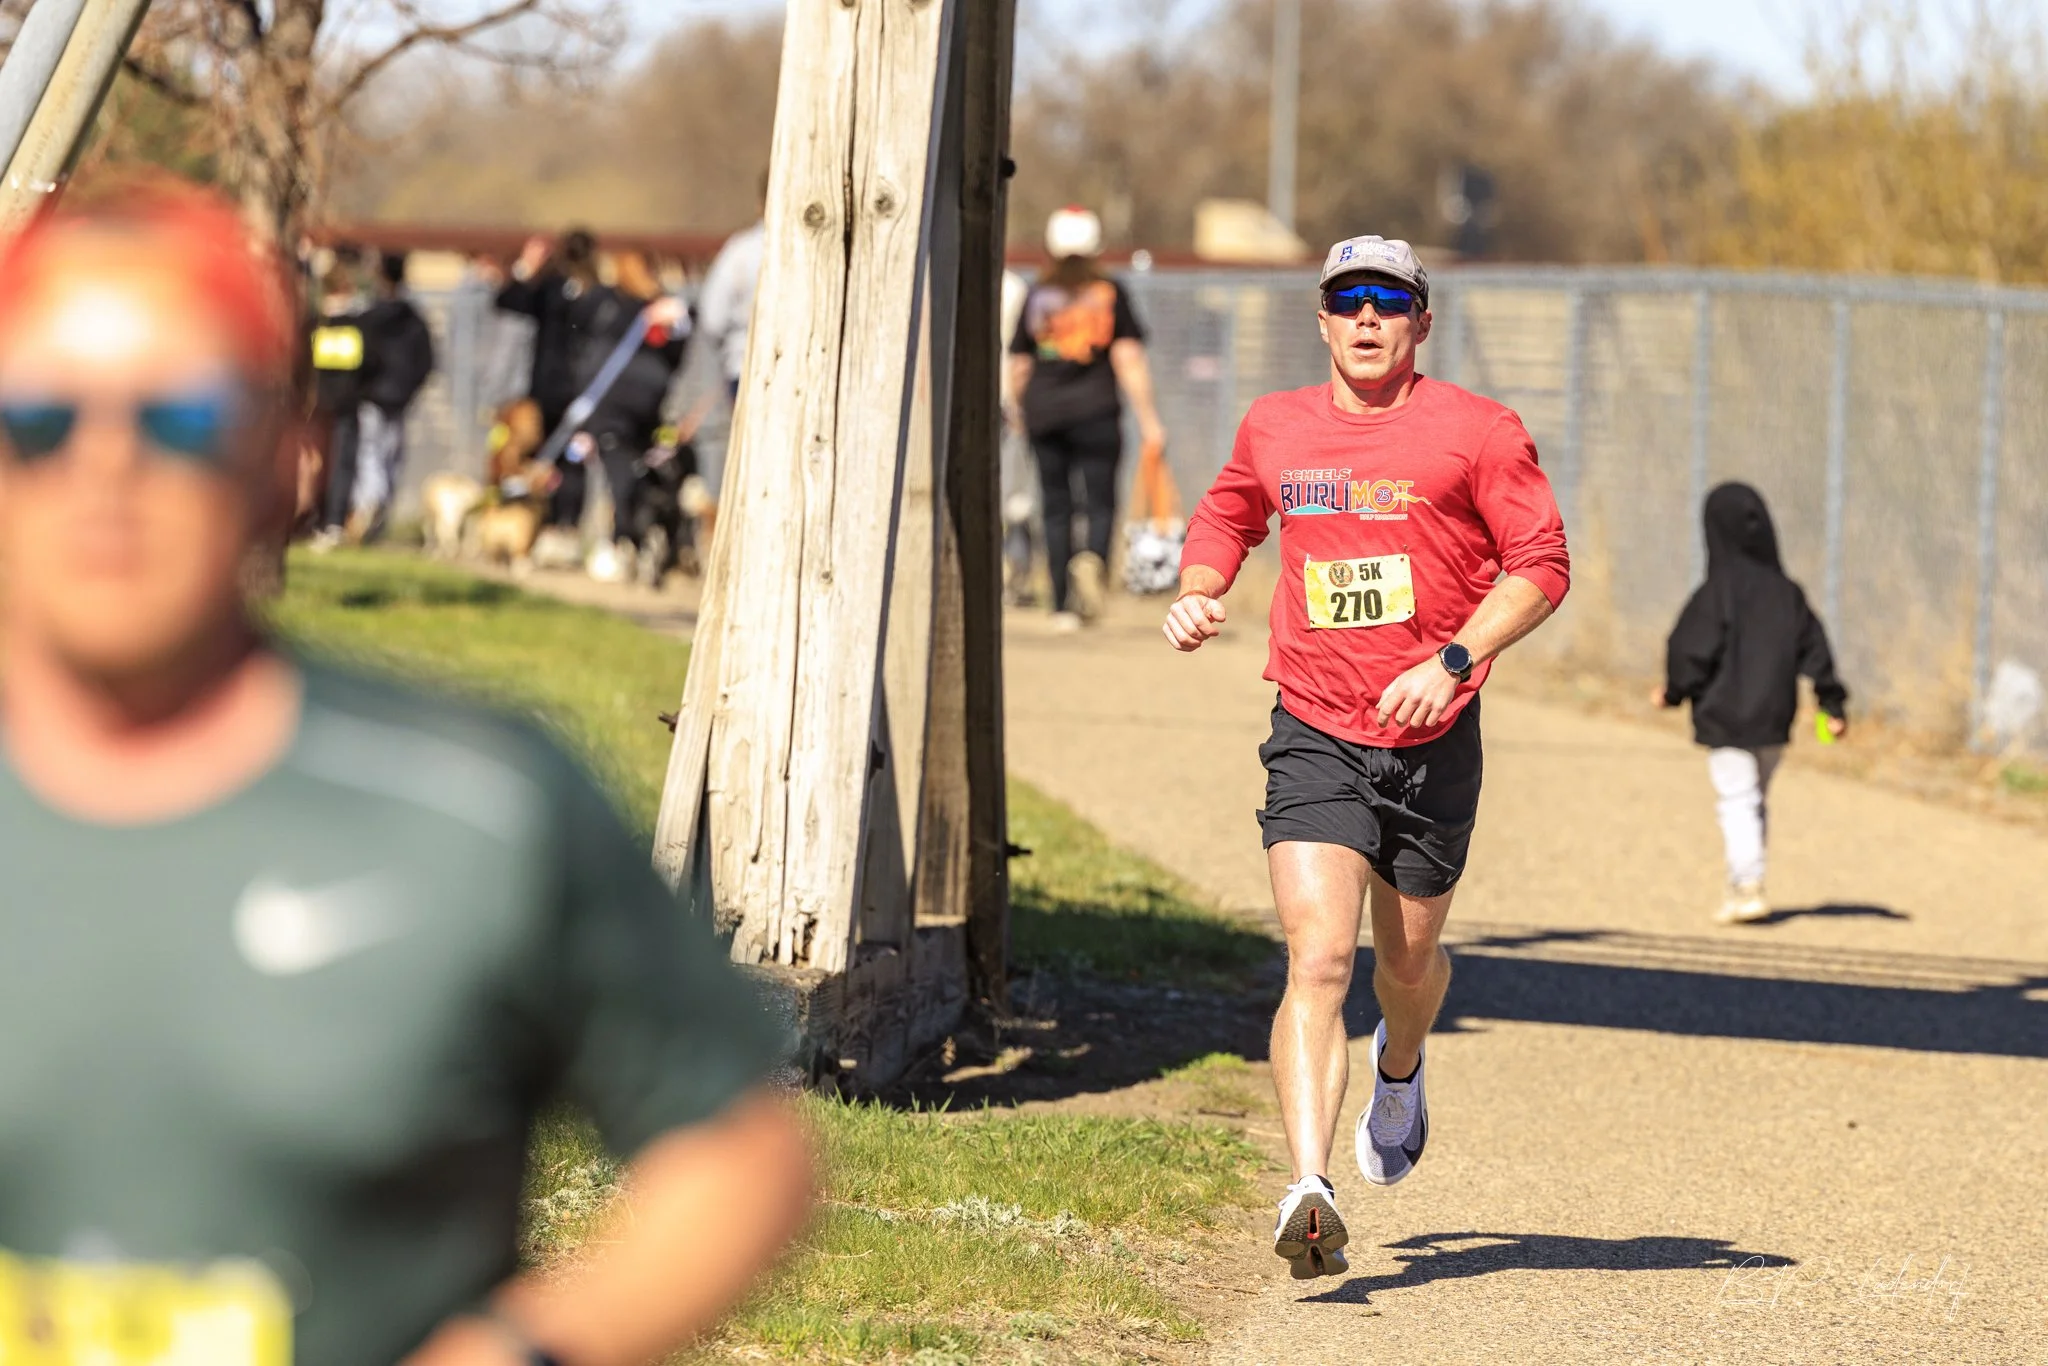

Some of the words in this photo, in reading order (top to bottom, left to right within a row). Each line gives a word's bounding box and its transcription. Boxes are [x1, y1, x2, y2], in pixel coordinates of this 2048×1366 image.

[1377, 489, 1391, 503] 25
[1359, 562, 1383, 582] 5K
[1330, 589, 1383, 623] 270
